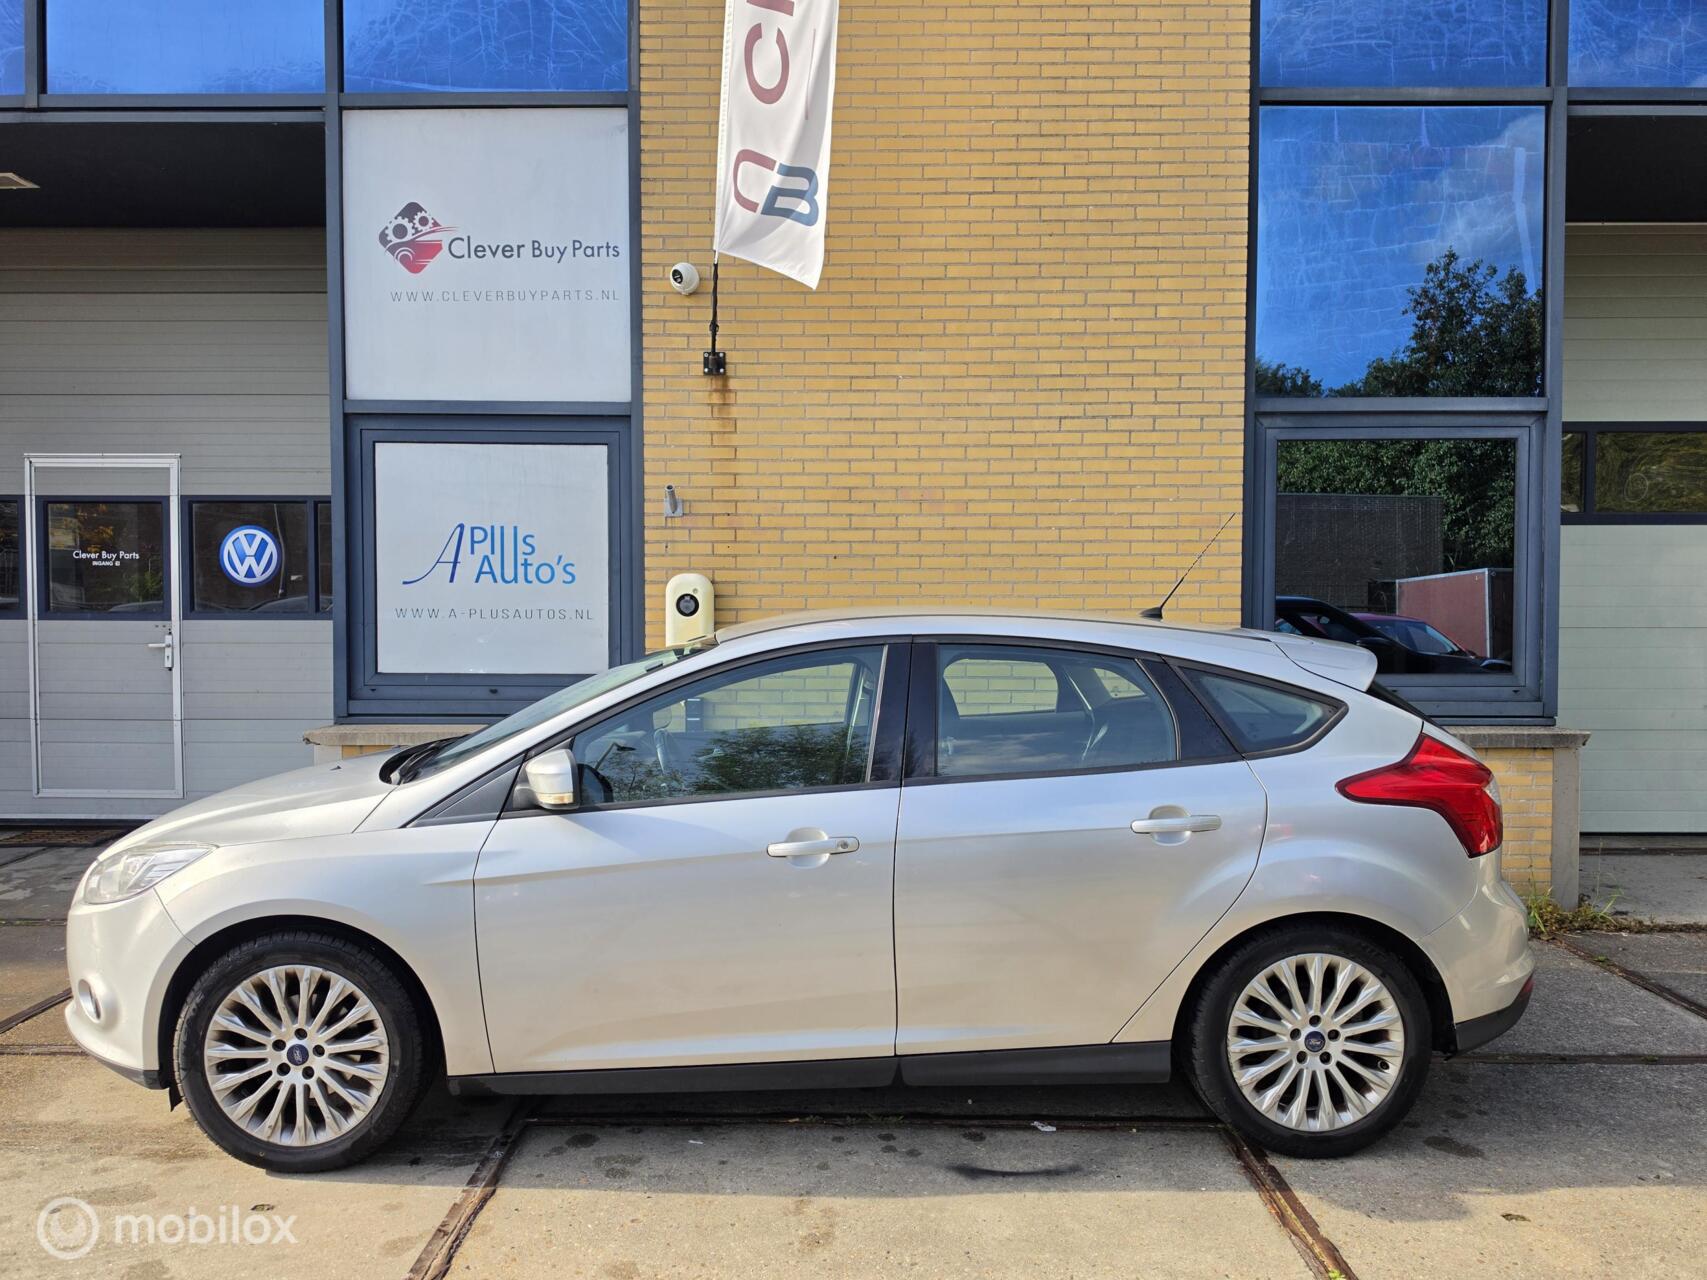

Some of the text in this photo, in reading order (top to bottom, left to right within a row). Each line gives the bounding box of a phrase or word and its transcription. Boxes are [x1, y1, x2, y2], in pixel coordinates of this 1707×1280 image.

[448, 235, 620, 264] Clever Buy Parts
[390, 289, 621, 303] WWW.CLEVERBUYPARTS.NL
[72, 550, 140, 561] Clever Buy Parts
[395, 608, 594, 620] WWW.A-PLUSAUTOS.NL
